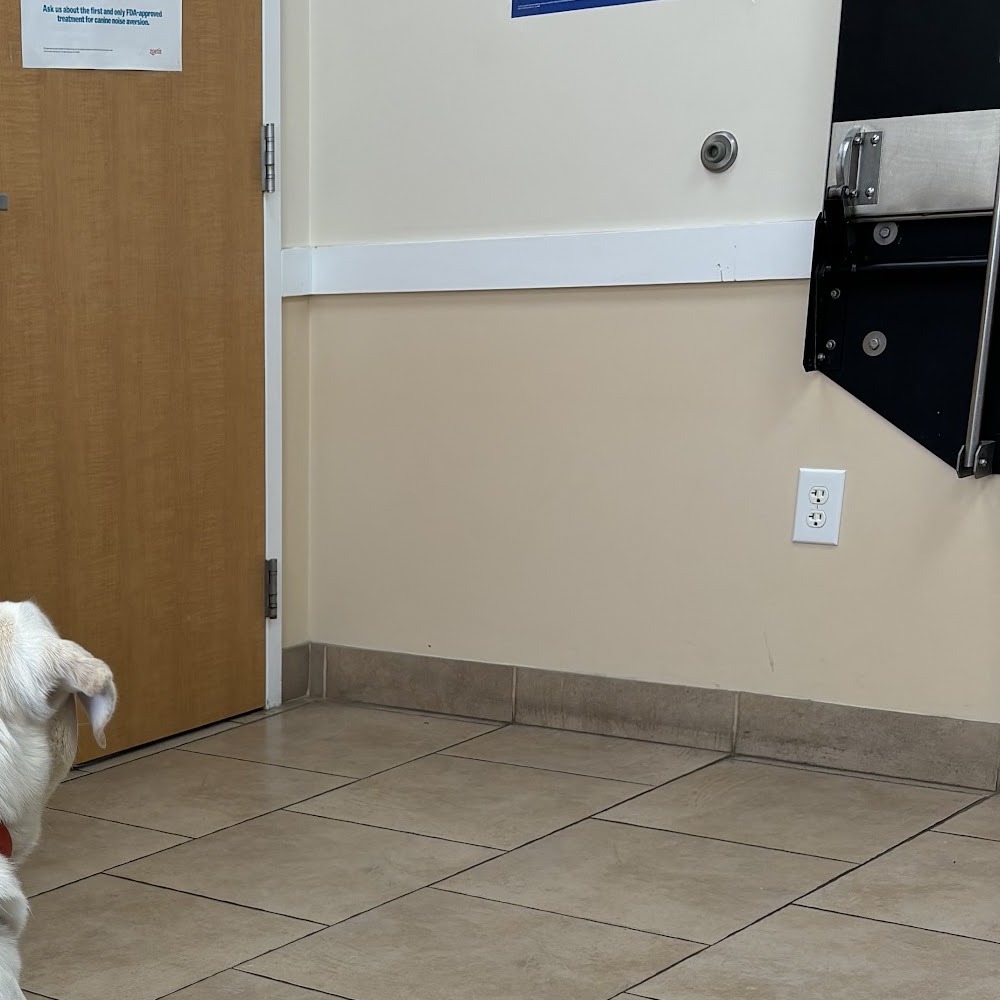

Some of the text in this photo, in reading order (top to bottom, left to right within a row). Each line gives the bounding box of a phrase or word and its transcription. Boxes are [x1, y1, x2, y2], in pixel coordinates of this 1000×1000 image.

[43, 5, 54, 13] Ask
[63, 5, 79, 14] about
[80, 6, 90, 14] the
[90, 6, 102, 15] first
[103, 7, 114, 16] and
[114, 8, 125, 17] only
[126, 8, 162, 18] FDA-approved
[57, 15, 150, 26] treatment for canine noise aversion.
